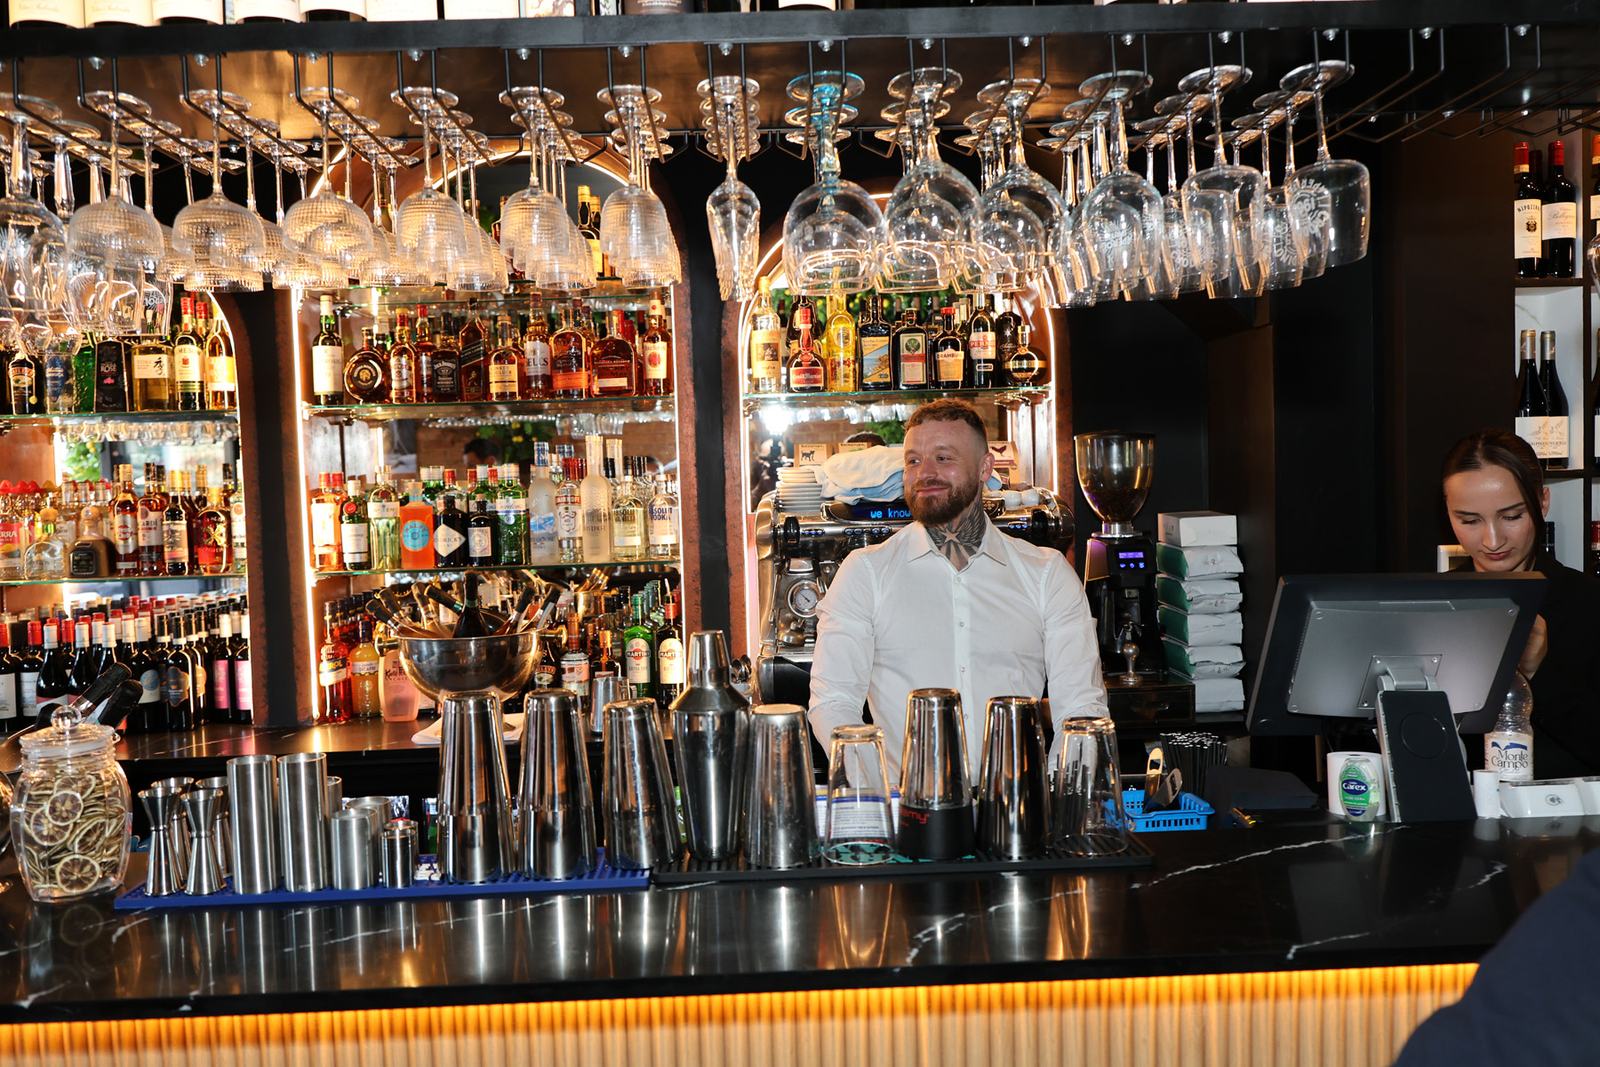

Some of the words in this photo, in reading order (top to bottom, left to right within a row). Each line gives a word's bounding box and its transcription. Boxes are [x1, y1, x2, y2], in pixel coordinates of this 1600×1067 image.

[870, 510, 883, 519] we
[1498, 750, 1528, 761] Monte
[1491, 756, 1528, 769] Campo
[1342, 782, 1367, 791] Carex
